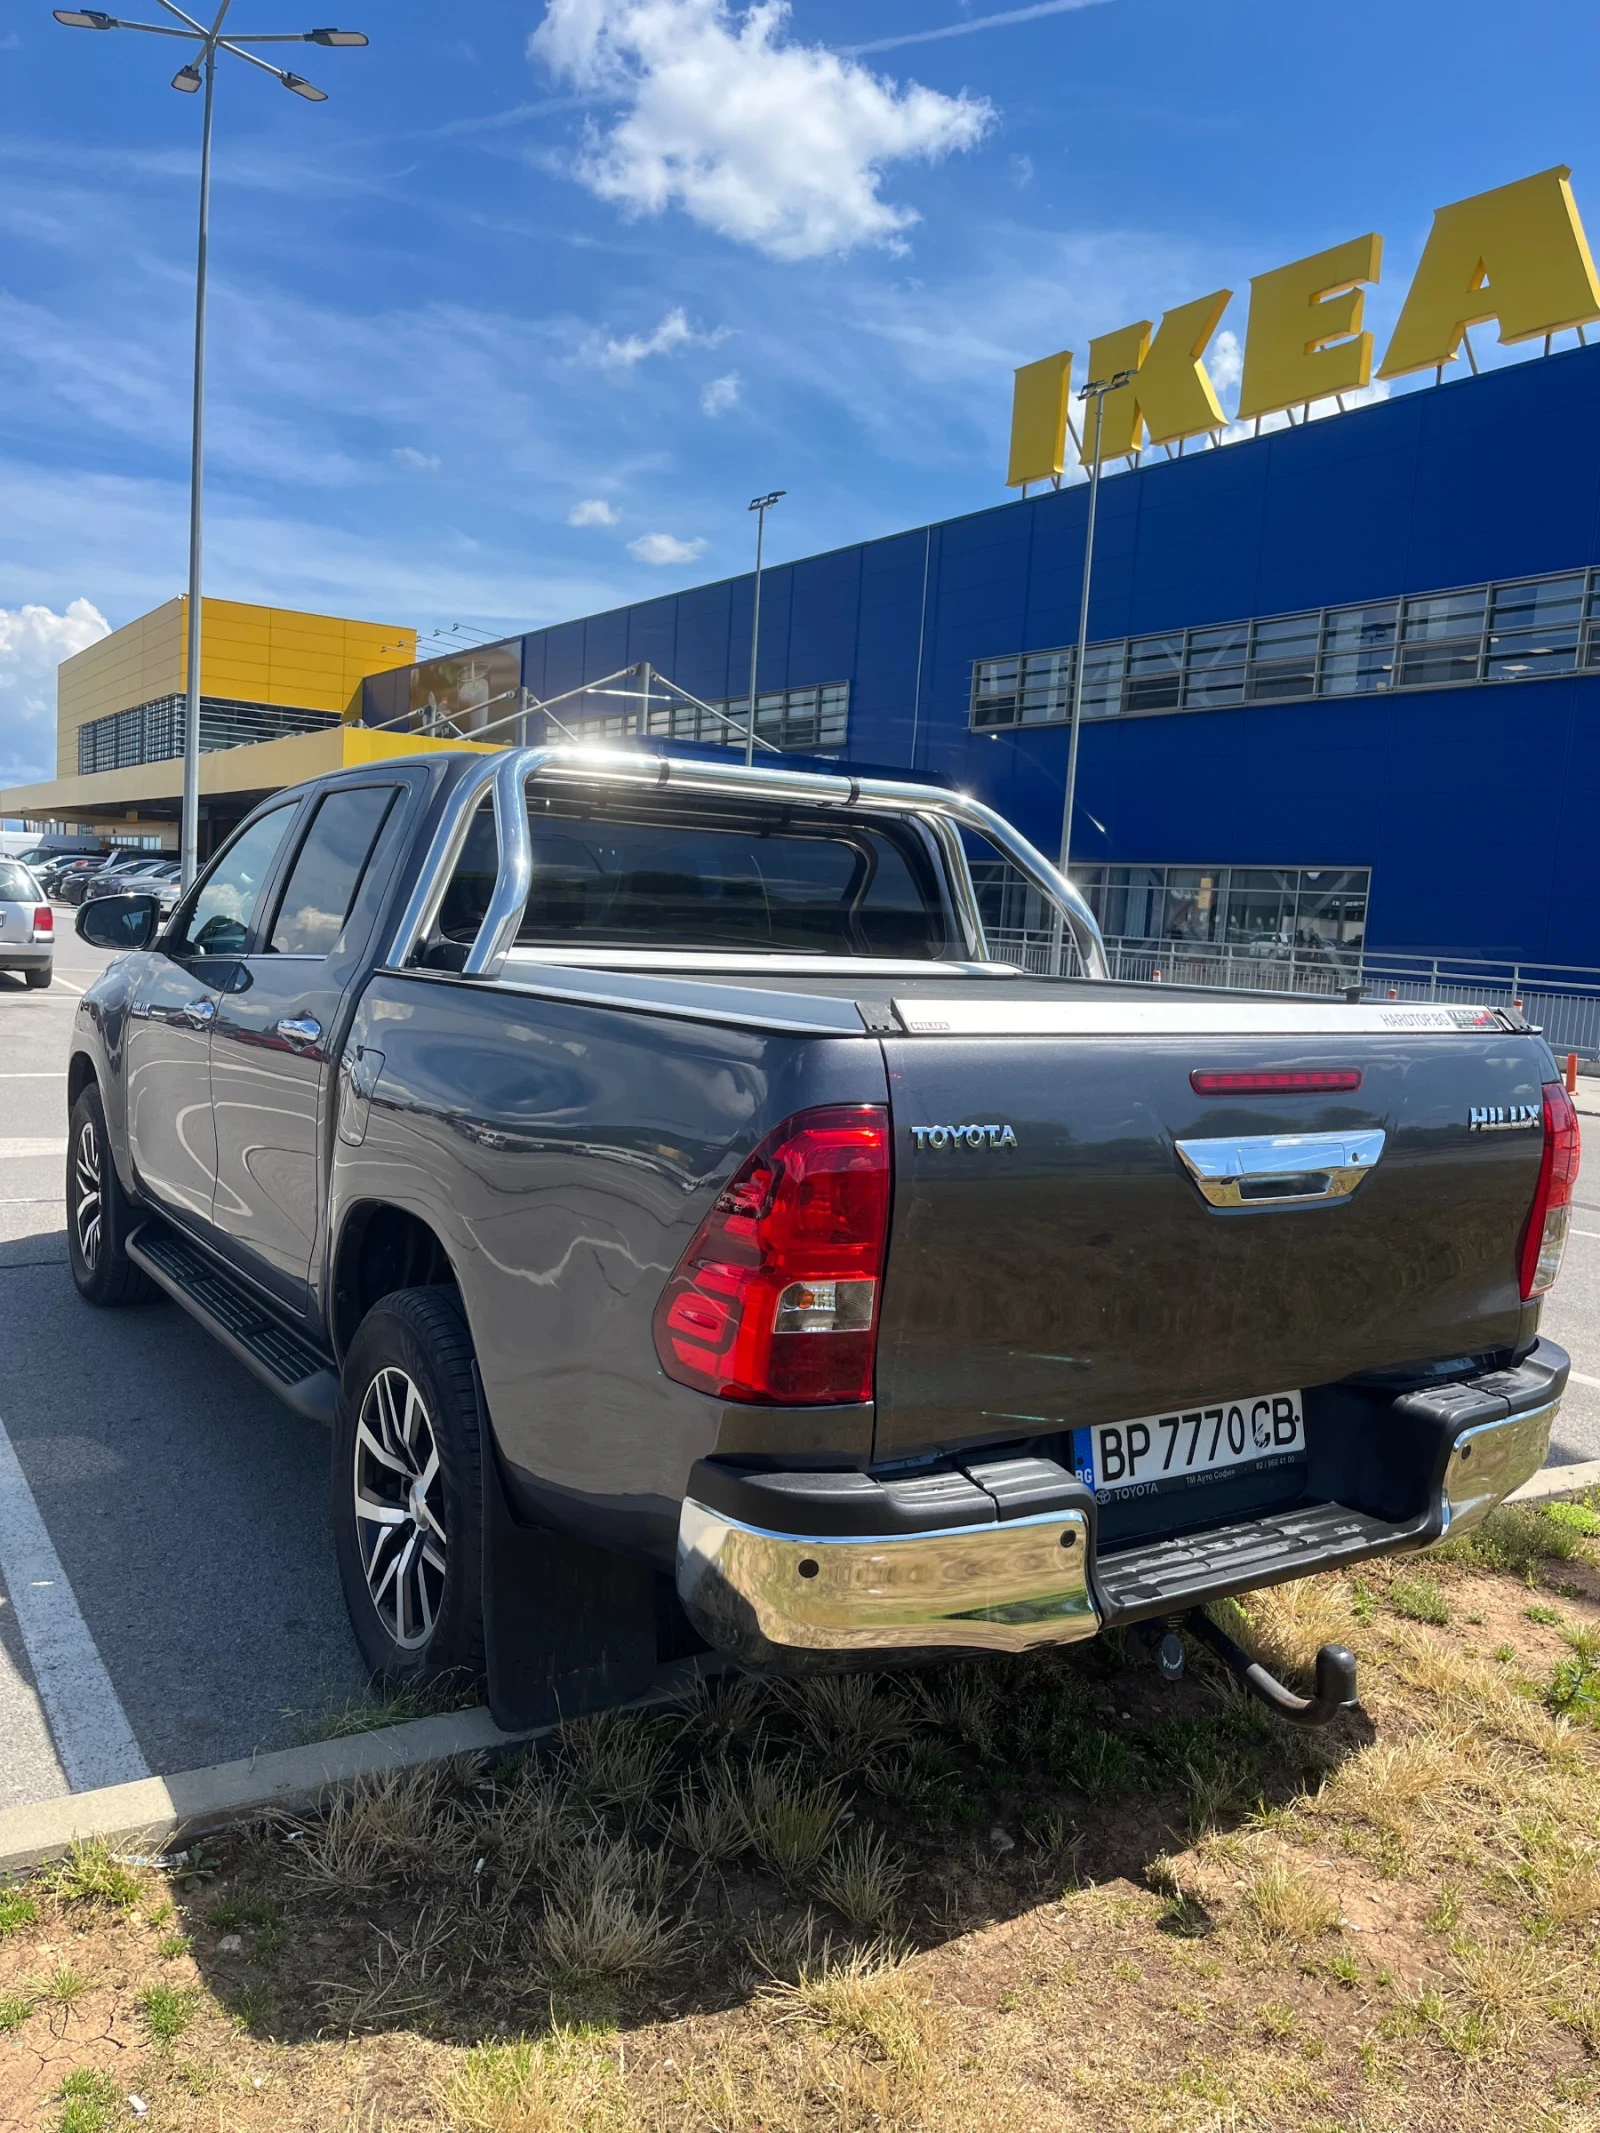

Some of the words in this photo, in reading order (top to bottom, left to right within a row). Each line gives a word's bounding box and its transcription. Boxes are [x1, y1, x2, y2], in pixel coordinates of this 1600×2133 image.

[1005, 163, 1600, 488] IKEA
[911, 1021, 948, 1031] HILUX
[1379, 1012, 1451, 1027] HARDTOP.BG
[1469, 1104, 1540, 1132] HILUX
[911, 1124, 1018, 1149] TOYOTA
[1099, 1423, 1151, 1482] BP
[1158, 1405, 1245, 1471] 7770
[1251, 1397, 1297, 1449] CB
[1075, 1467, 1093, 1484] BG
[1213, 1468, 1236, 1480] София
[1114, 1482, 1159, 1501] TOYOTA
